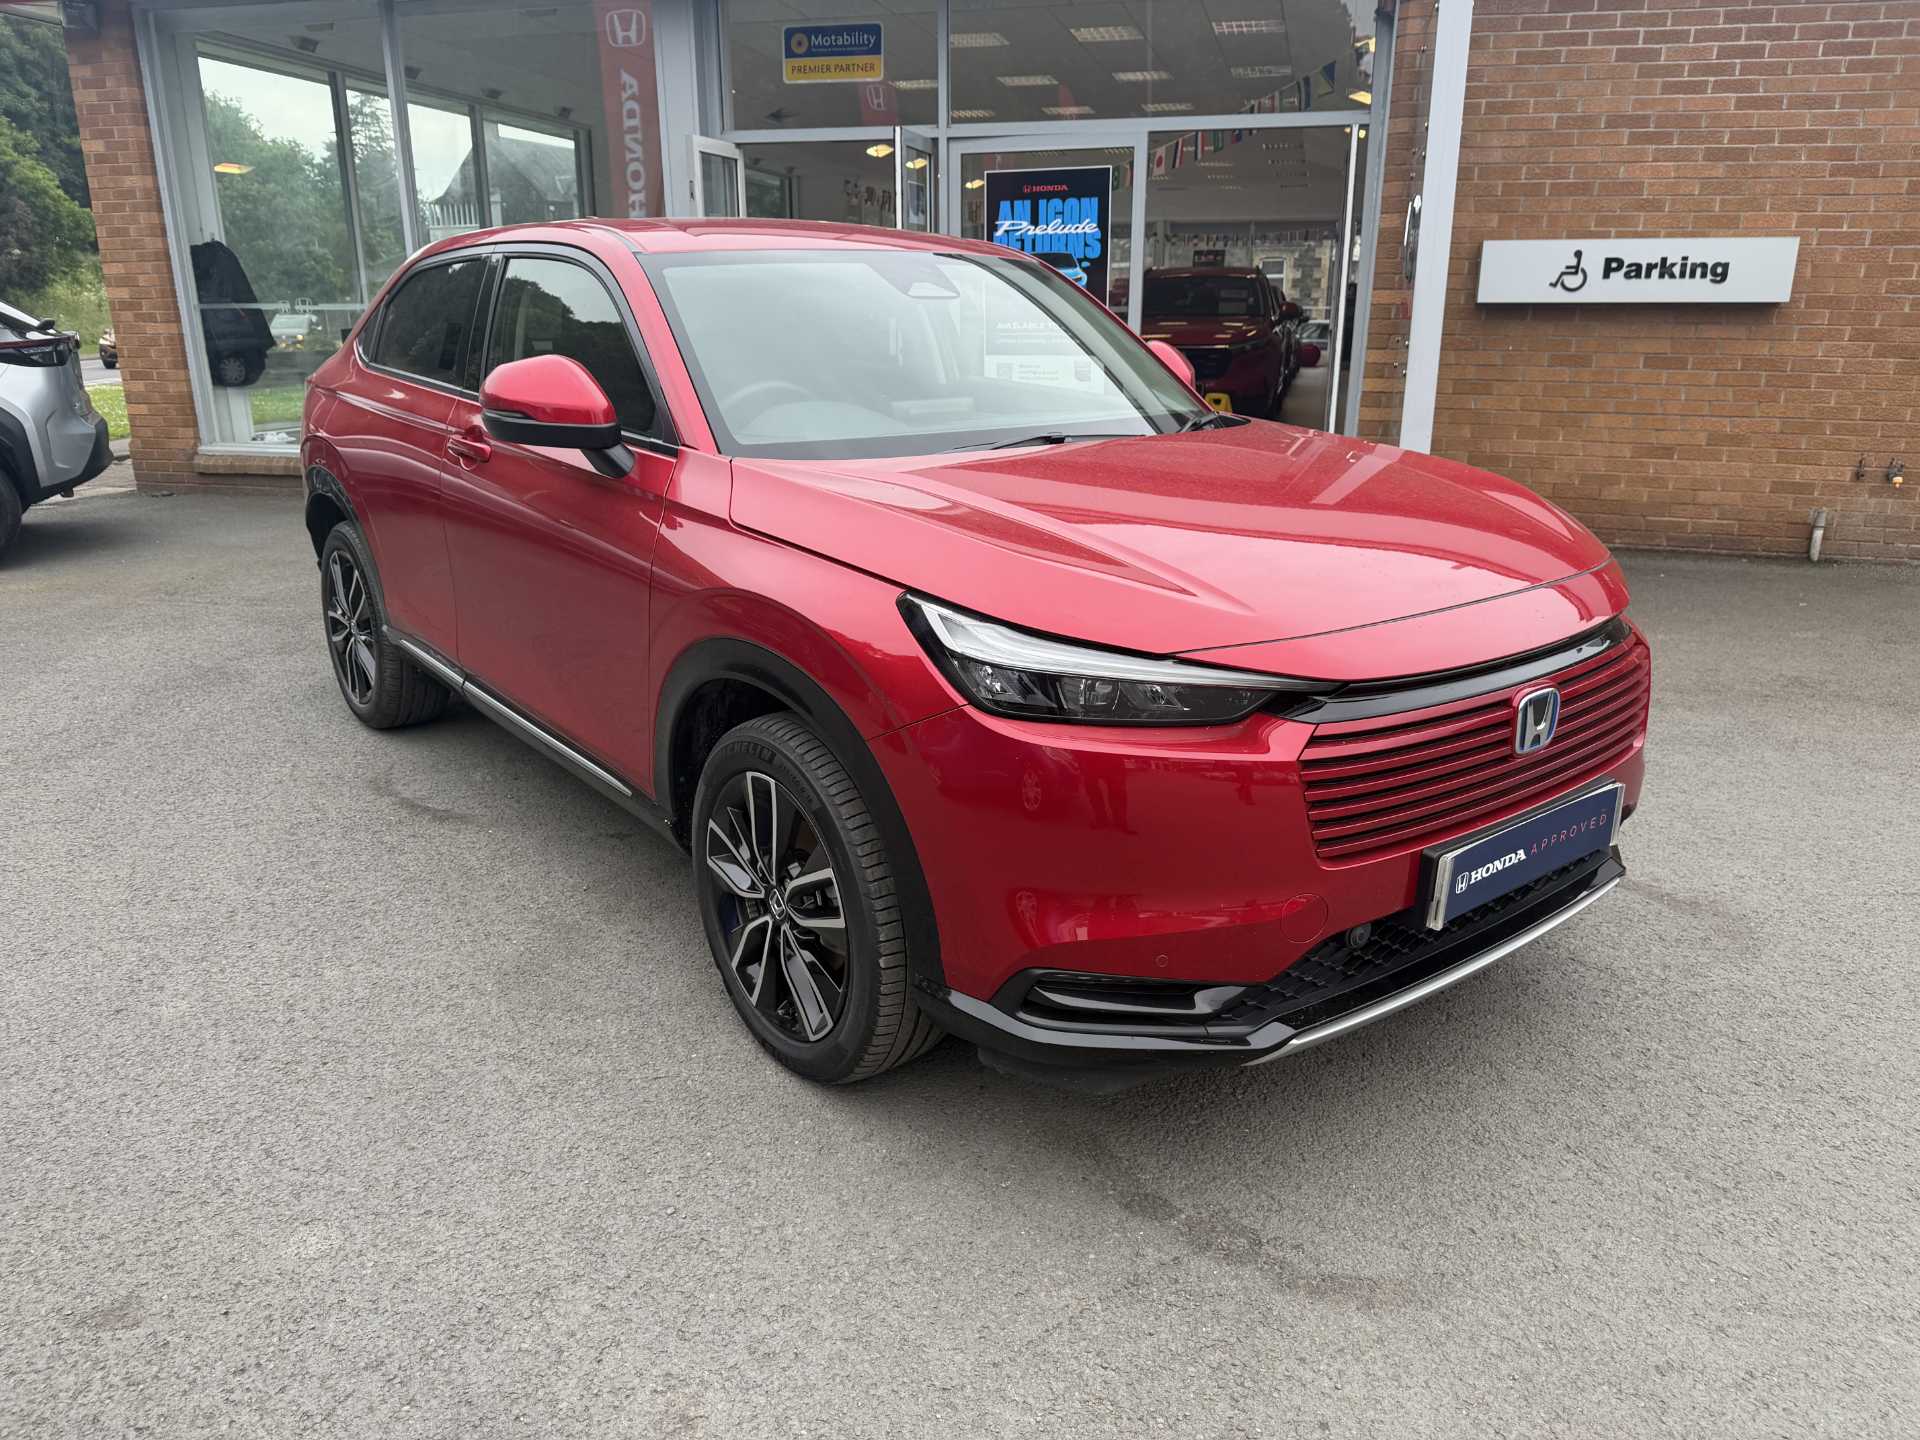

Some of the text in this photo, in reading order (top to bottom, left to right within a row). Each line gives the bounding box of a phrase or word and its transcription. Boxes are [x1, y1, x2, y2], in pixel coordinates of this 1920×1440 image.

[811, 32, 876, 48] Motability
[792, 62, 875, 74] PREMIER PARTNER
[1032, 184, 1068, 192] HONDA
[997, 197, 1098, 228] AN ICON
[995, 218, 1099, 237] Prelude
[1602, 256, 1730, 284] Parking
[1470, 814, 1607, 885] HONDA APPROVED
